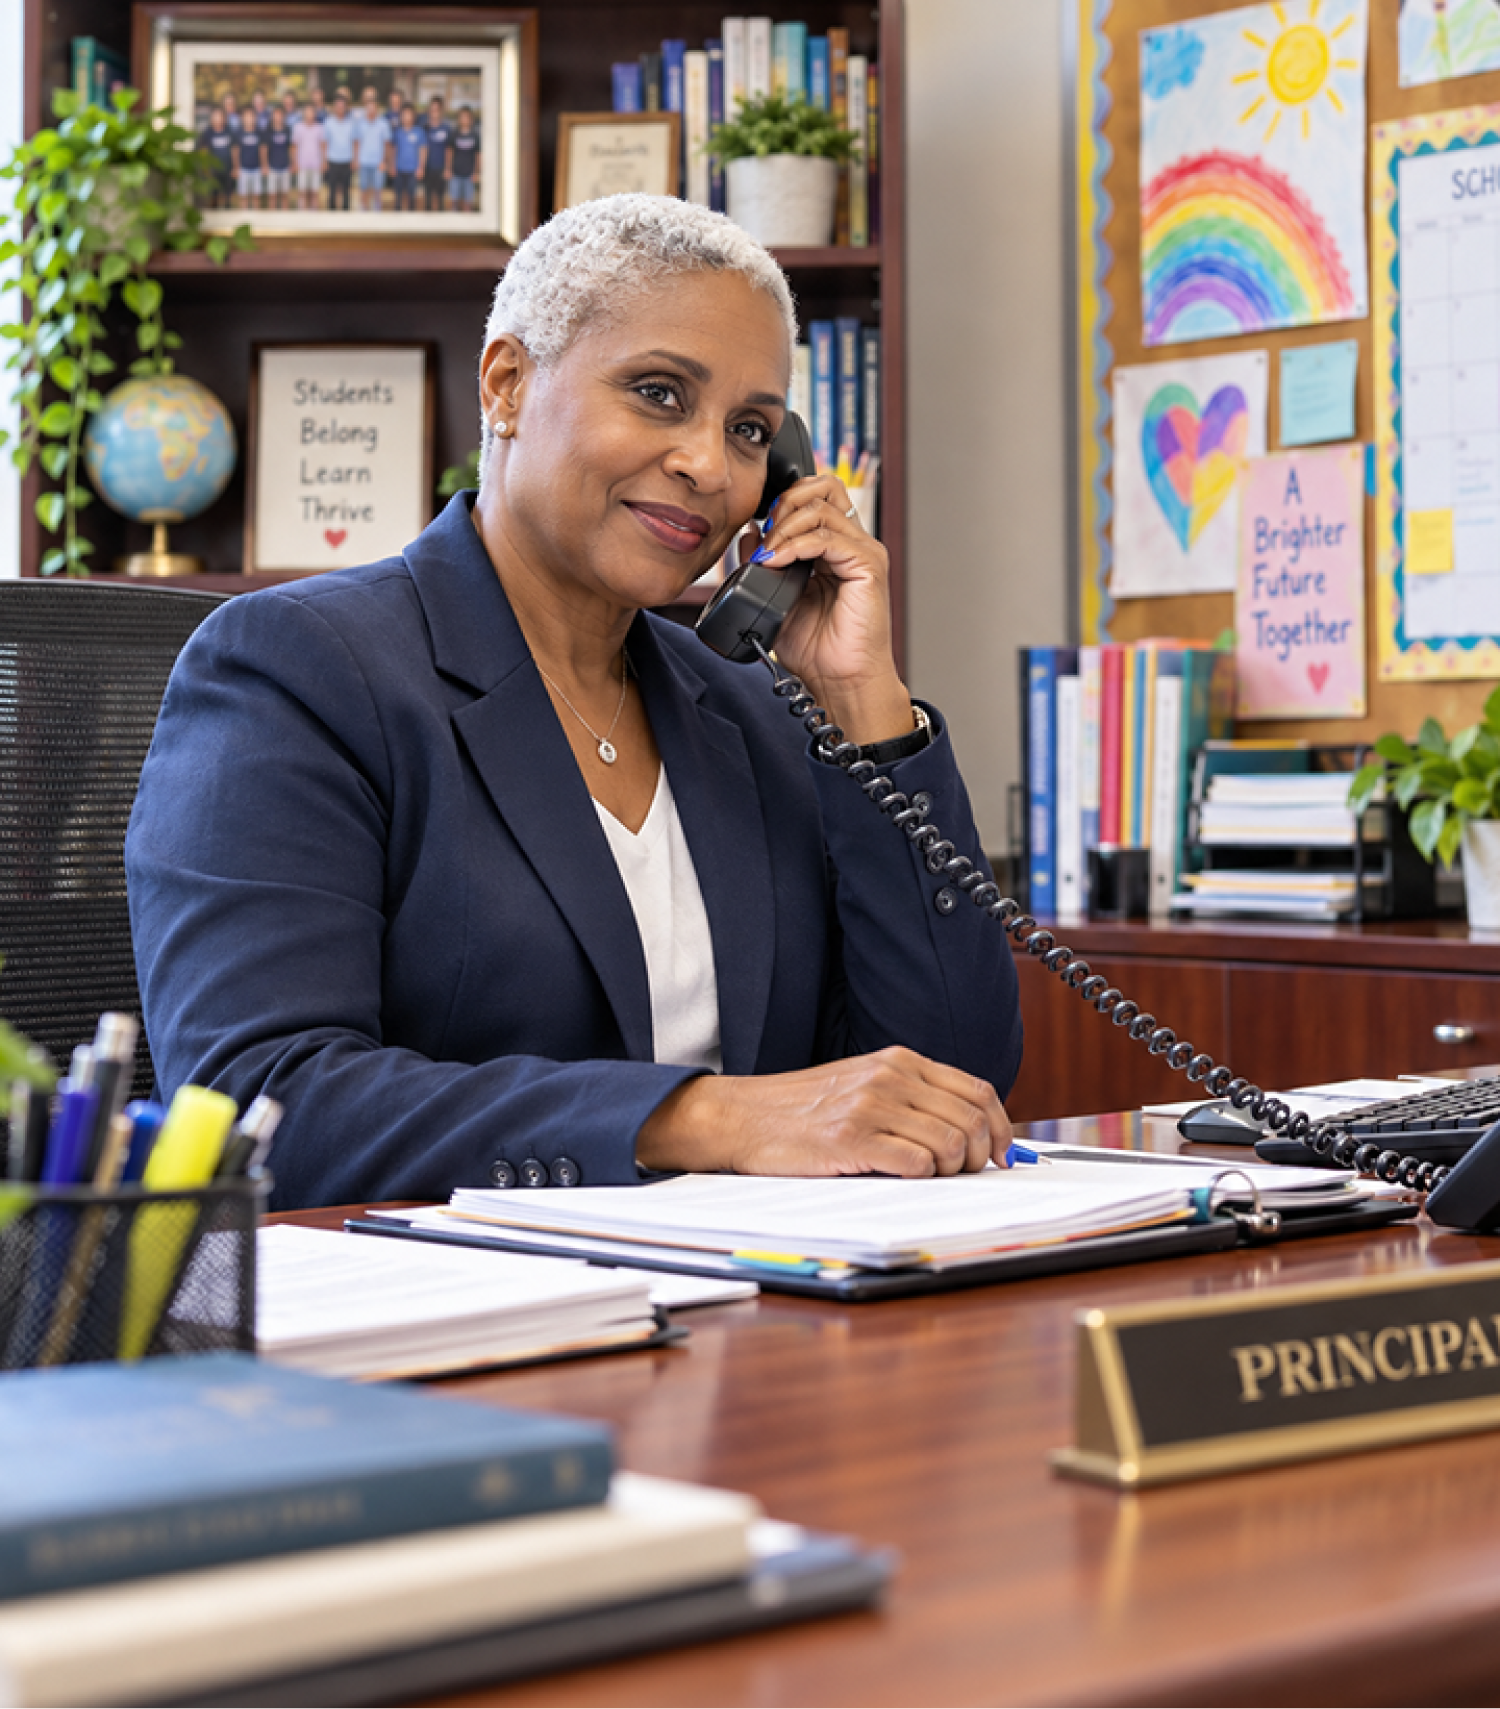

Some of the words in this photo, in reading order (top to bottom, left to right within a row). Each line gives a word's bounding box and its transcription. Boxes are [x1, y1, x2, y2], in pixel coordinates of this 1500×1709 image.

[1450, 164, 1500, 201] SCH
[294, 378, 394, 406] Students
[301, 417, 378, 453] Belong
[301, 457, 372, 485] Learn
[1283, 466, 1302, 506] A
[299, 497, 375, 522] Thrive
[1254, 514, 1346, 564] Brighter
[1253, 562, 1326, 599] Future
[1251, 607, 1352, 662] Together
[1231, 1314, 1500, 1402] PRINCIPA
